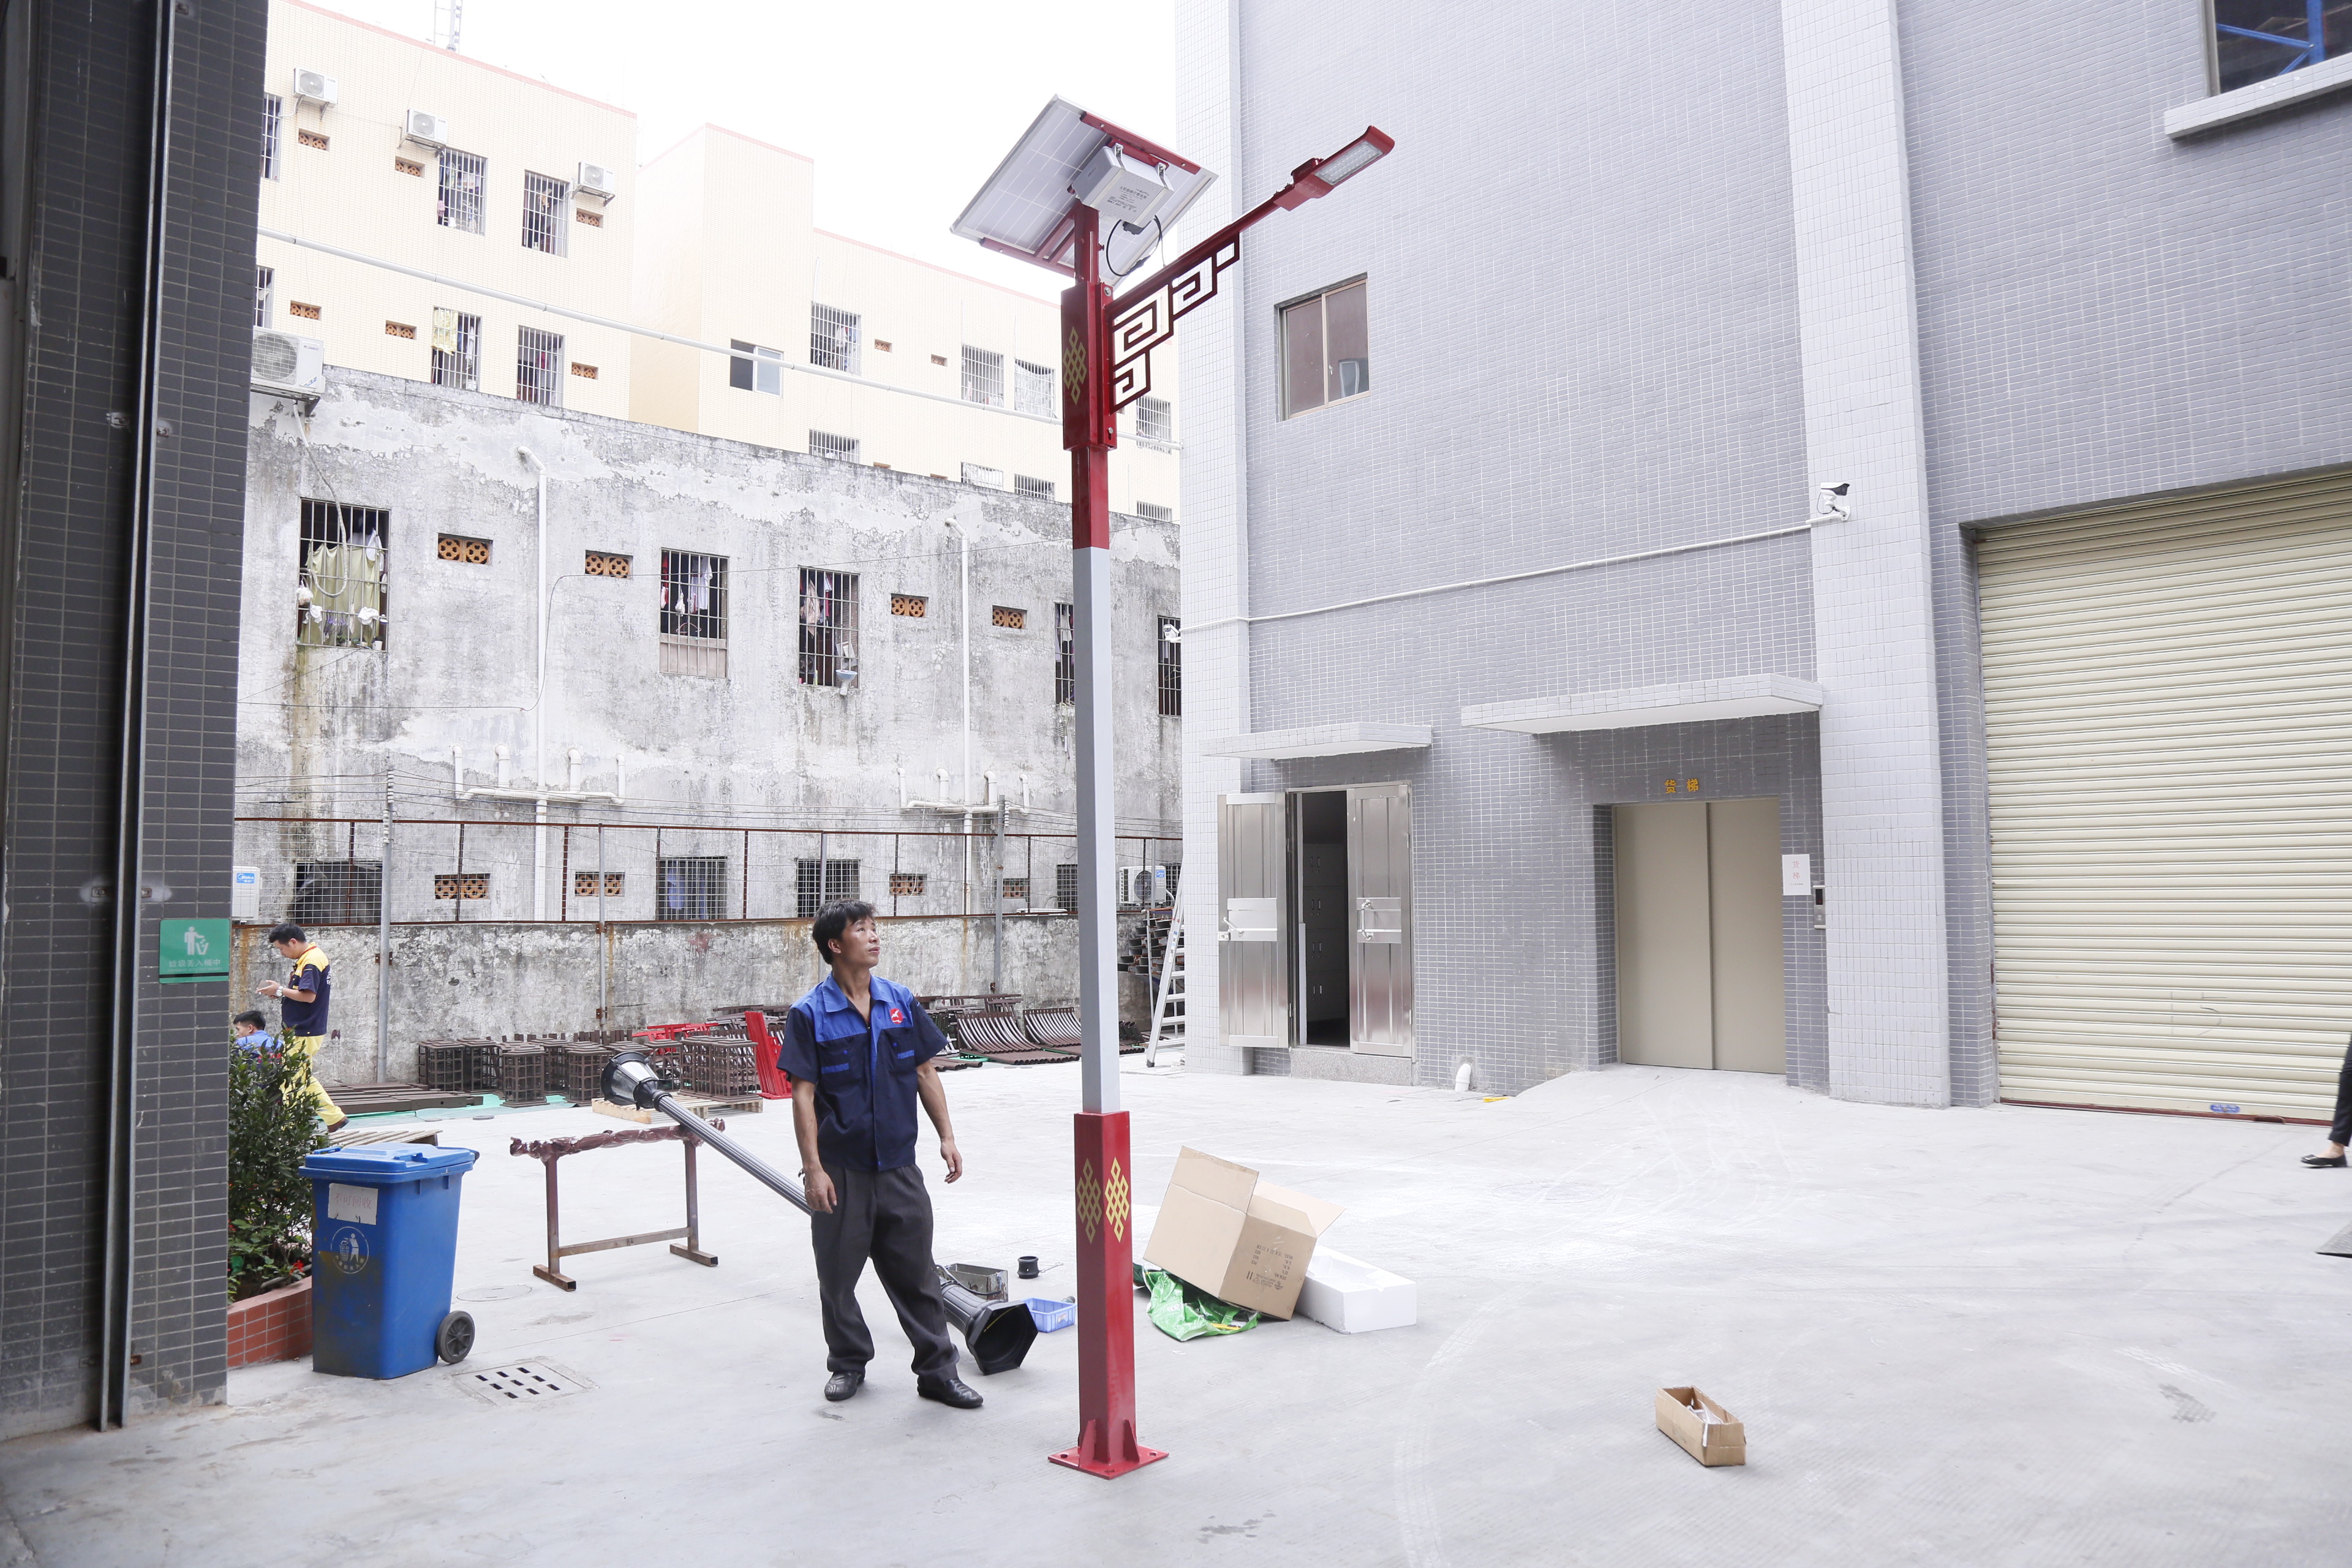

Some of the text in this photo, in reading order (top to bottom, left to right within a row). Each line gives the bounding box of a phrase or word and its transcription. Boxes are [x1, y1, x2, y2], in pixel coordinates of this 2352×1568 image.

[1664, 778, 1700, 794] 货梯
[168, 959, 221, 967] 垃圾丢入桶中
[334, 1193, 372, 1209] 不可回收
